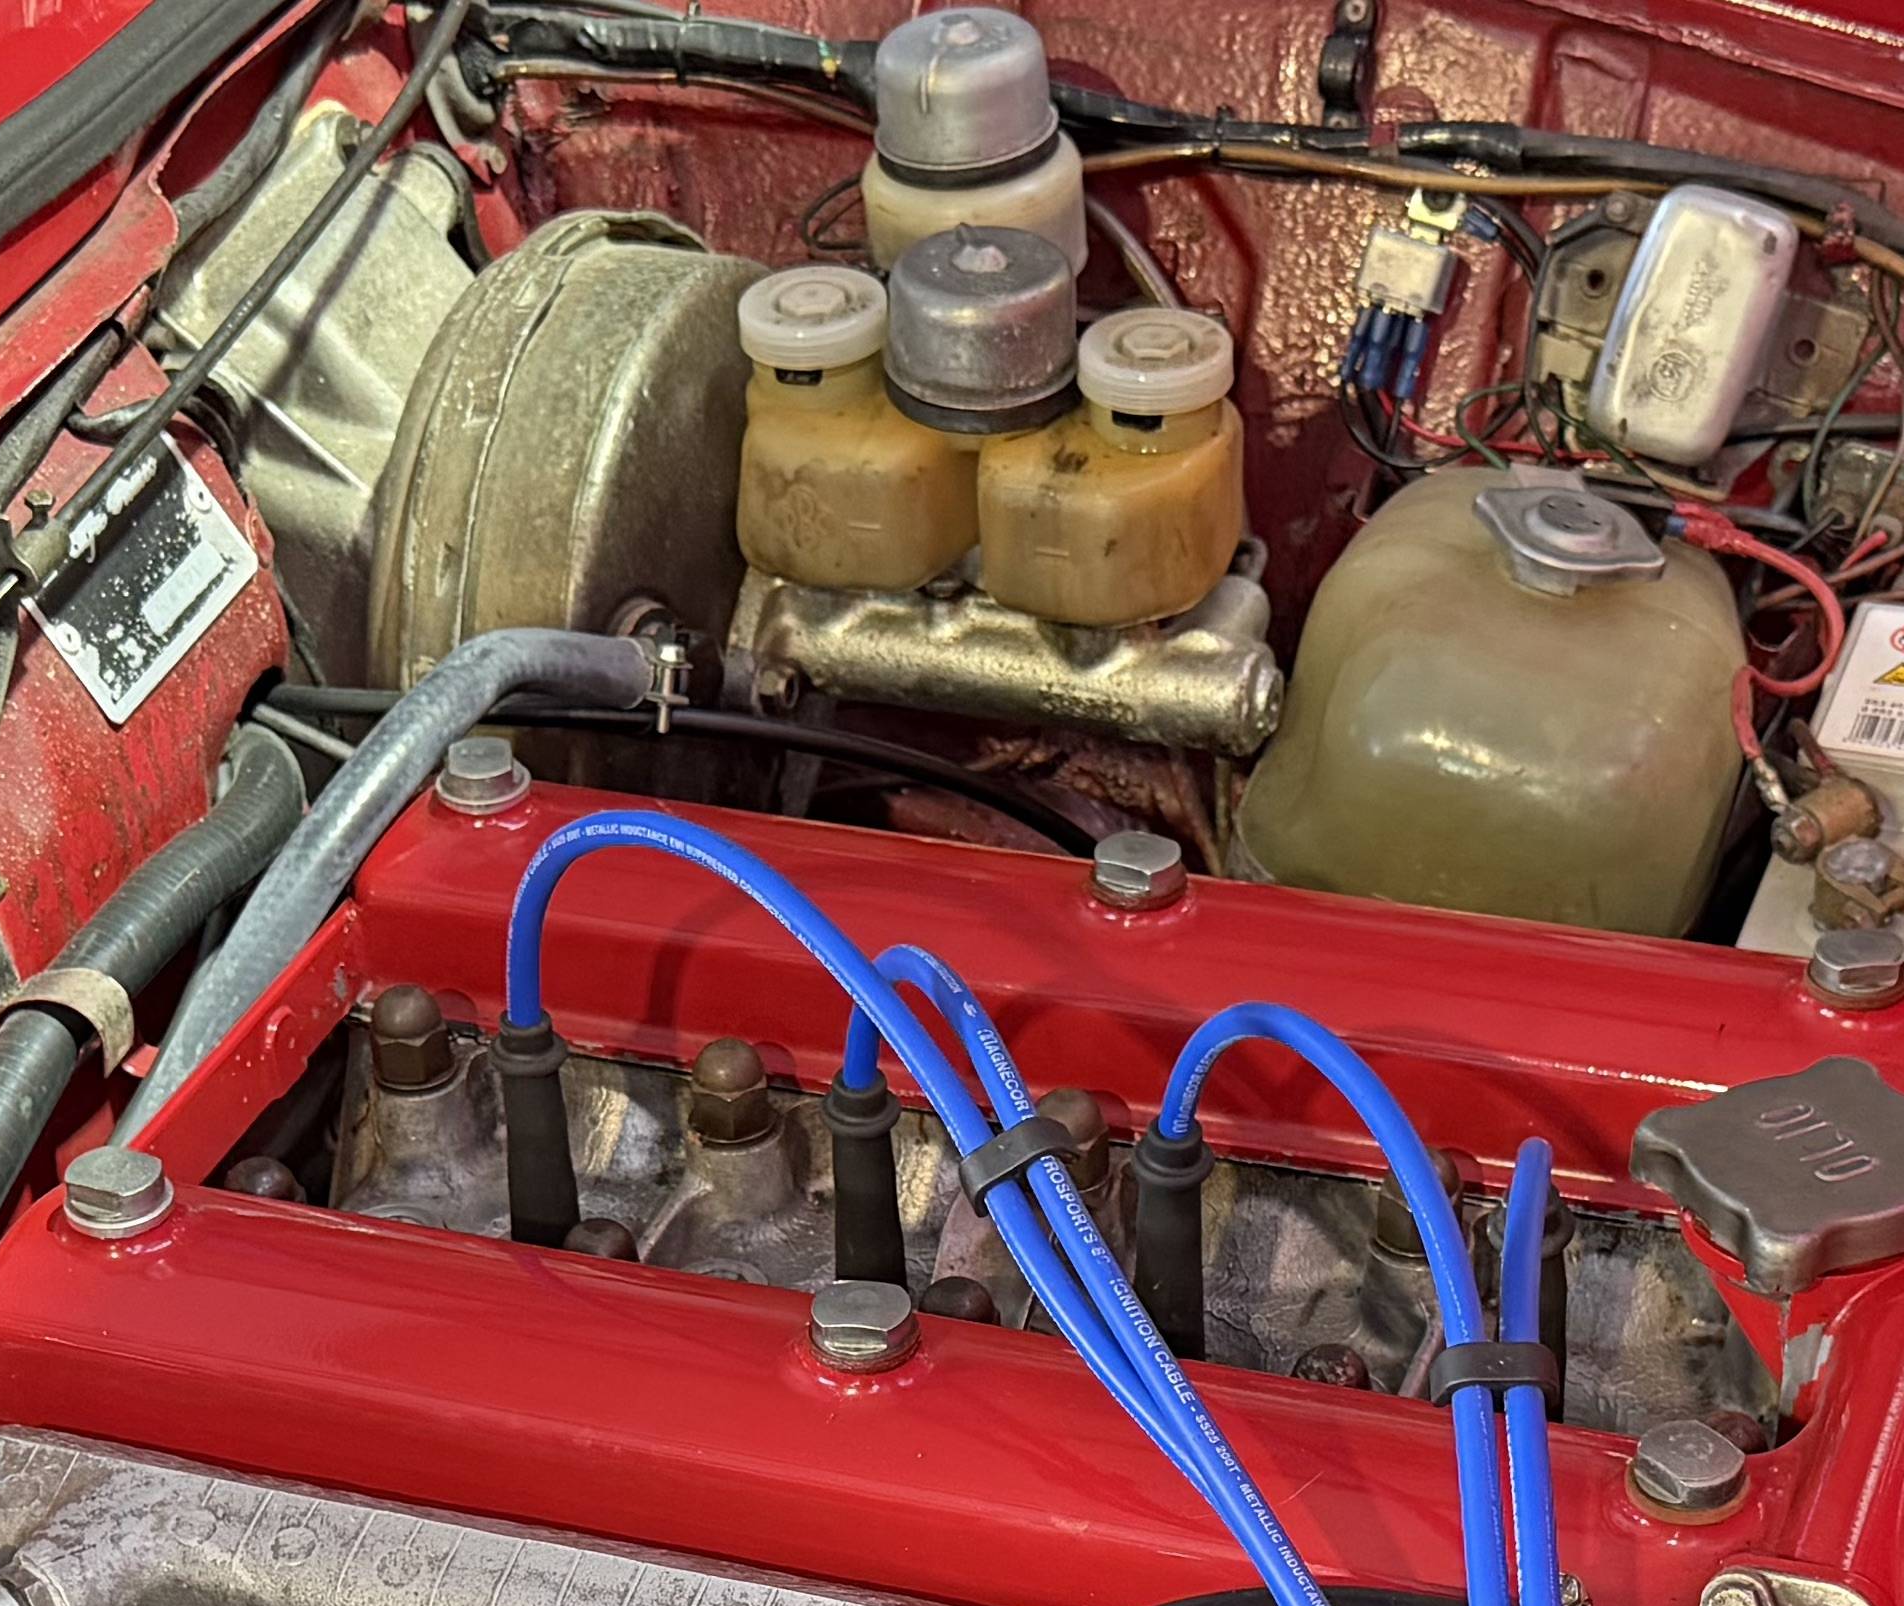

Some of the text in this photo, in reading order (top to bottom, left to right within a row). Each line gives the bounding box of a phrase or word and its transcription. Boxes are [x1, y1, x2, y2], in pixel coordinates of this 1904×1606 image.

[976, 1027, 1032, 1115] MAGNECOR
[1108, 1276, 1164, 1350] IGNITION
[1153, 1347, 1198, 1406] CABLE
[1239, 1481, 1284, 1545] METALLIC
